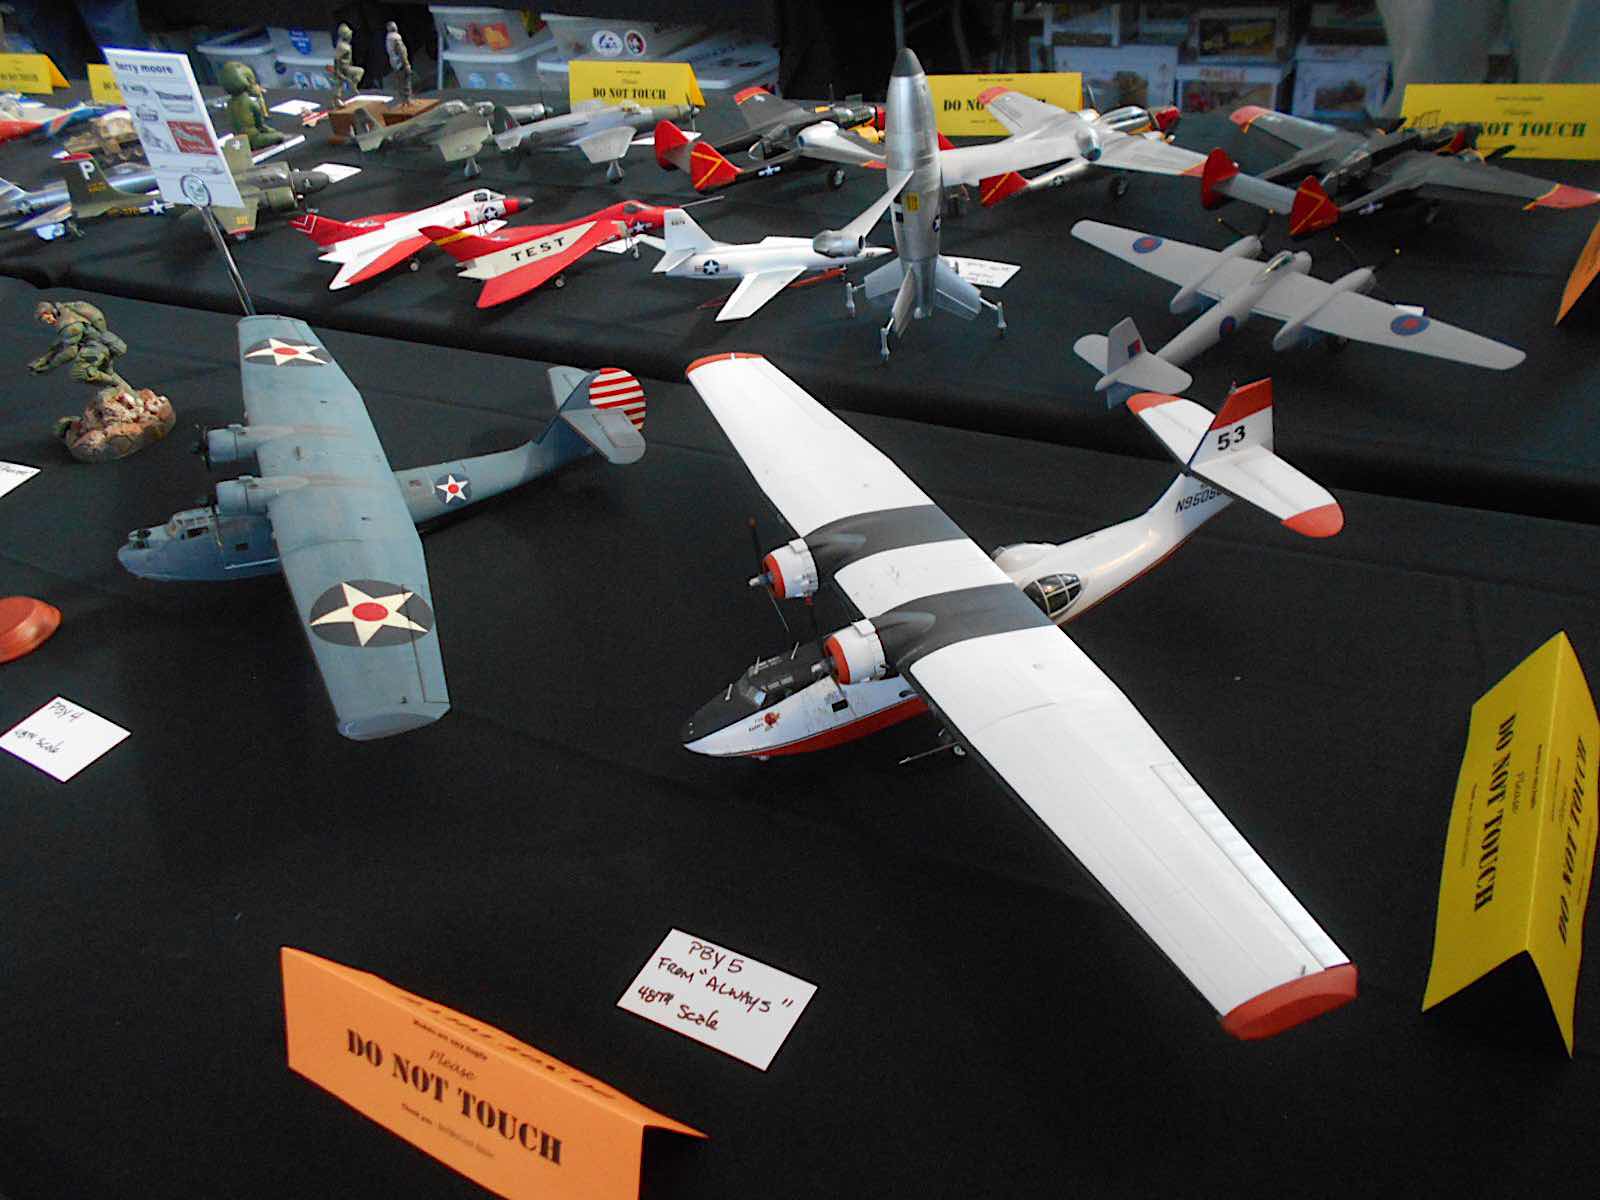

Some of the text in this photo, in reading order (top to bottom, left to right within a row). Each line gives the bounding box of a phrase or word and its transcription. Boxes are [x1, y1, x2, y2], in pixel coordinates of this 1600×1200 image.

[592, 87, 667, 100] DO NOT TOUCH
[943, 99, 985, 111] DO NO
[1519, 120, 1587, 137] TOUCH
[78, 160, 95, 180] P
[510, 236, 565, 262] TEST
[1217, 424, 1246, 451] 53
[1474, 712, 1517, 912] DO NOT TOUCH
[1561, 826, 1578, 886] NOT
[1558, 895, 1570, 945] DO
[657, 956, 695, 984] FROM
[688, 940, 745, 974] PBY 5
[347, 1028, 384, 1068] DO
[391, 1052, 450, 1104] NOT
[456, 1086, 563, 1167] TOUCH
